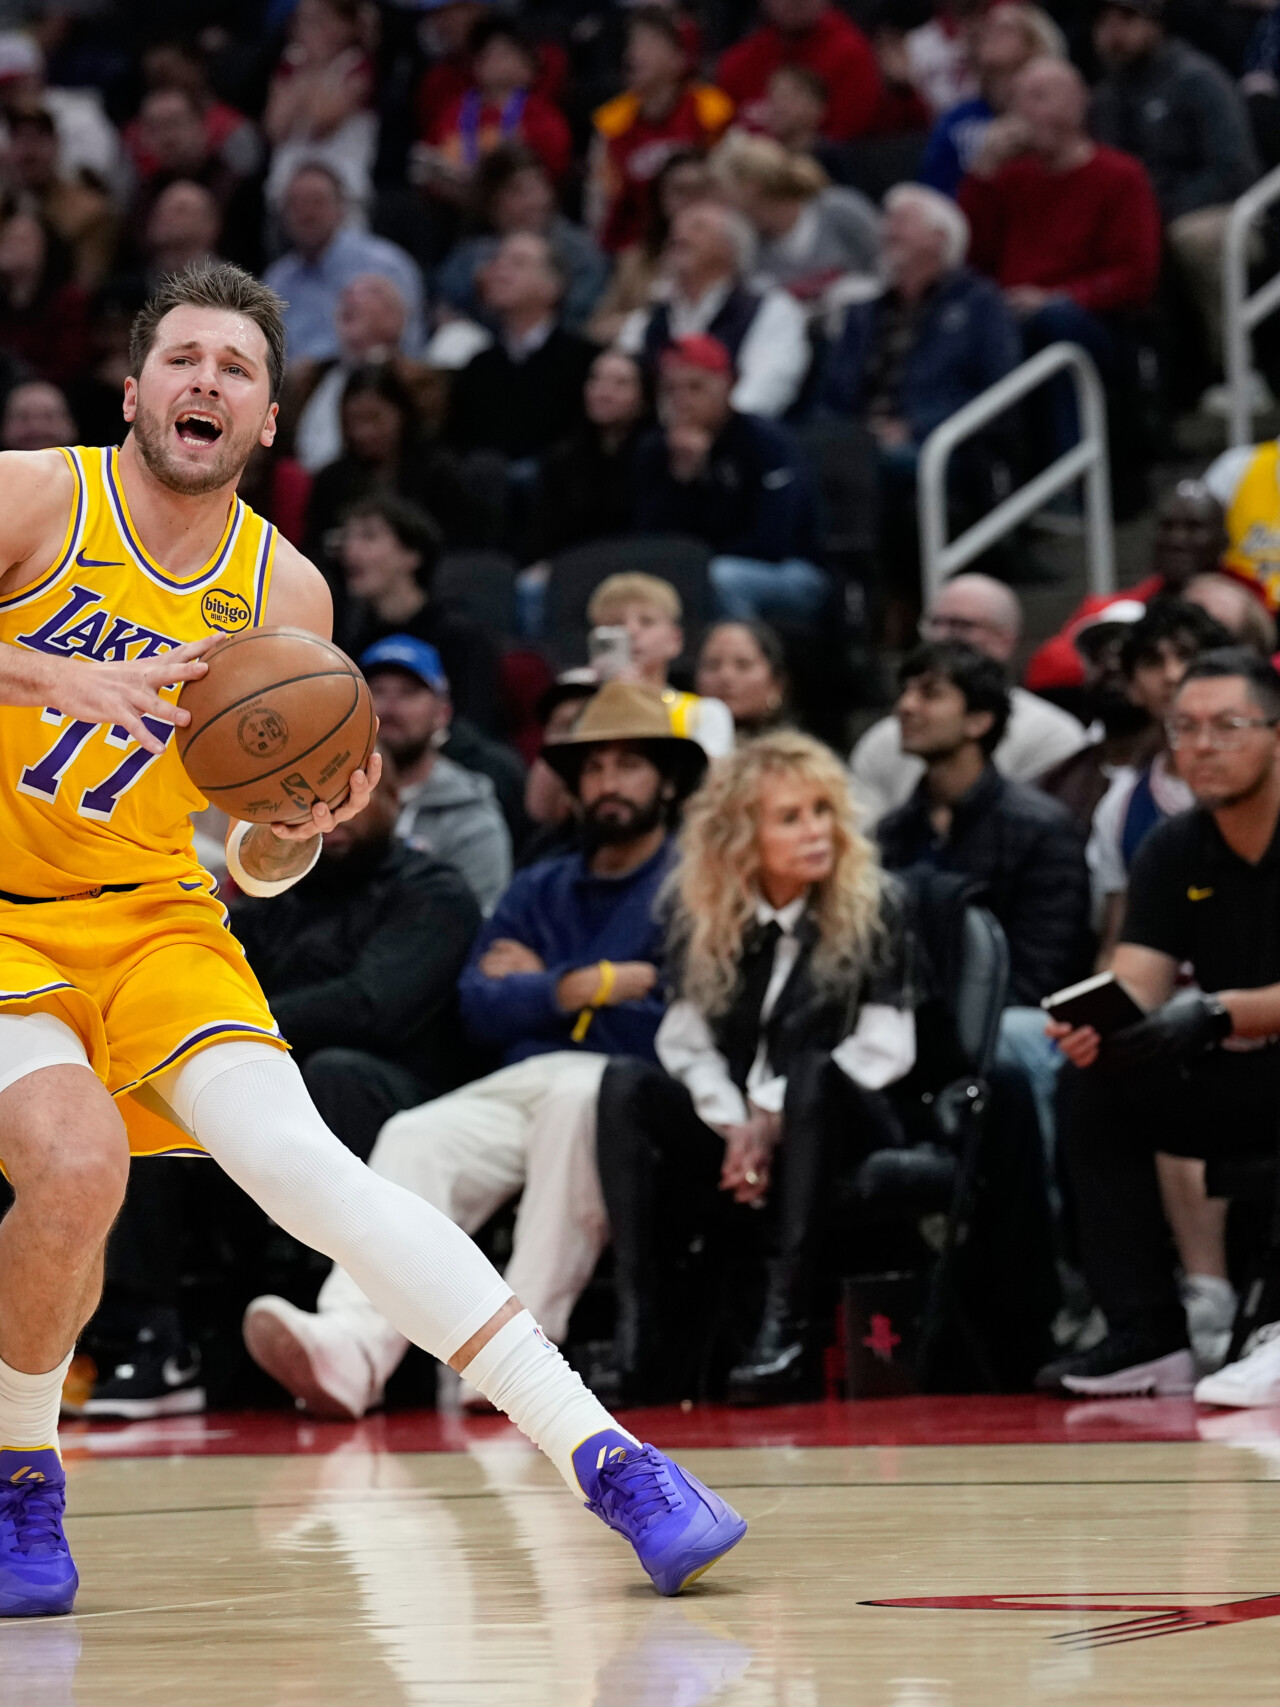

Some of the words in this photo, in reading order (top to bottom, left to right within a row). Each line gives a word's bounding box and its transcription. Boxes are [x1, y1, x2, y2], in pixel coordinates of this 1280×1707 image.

[15, 583, 199, 690] LAKE
[205, 597, 248, 622] bibigo
[211, 613, 228, 624] 비비고
[16, 706, 175, 822] 77
